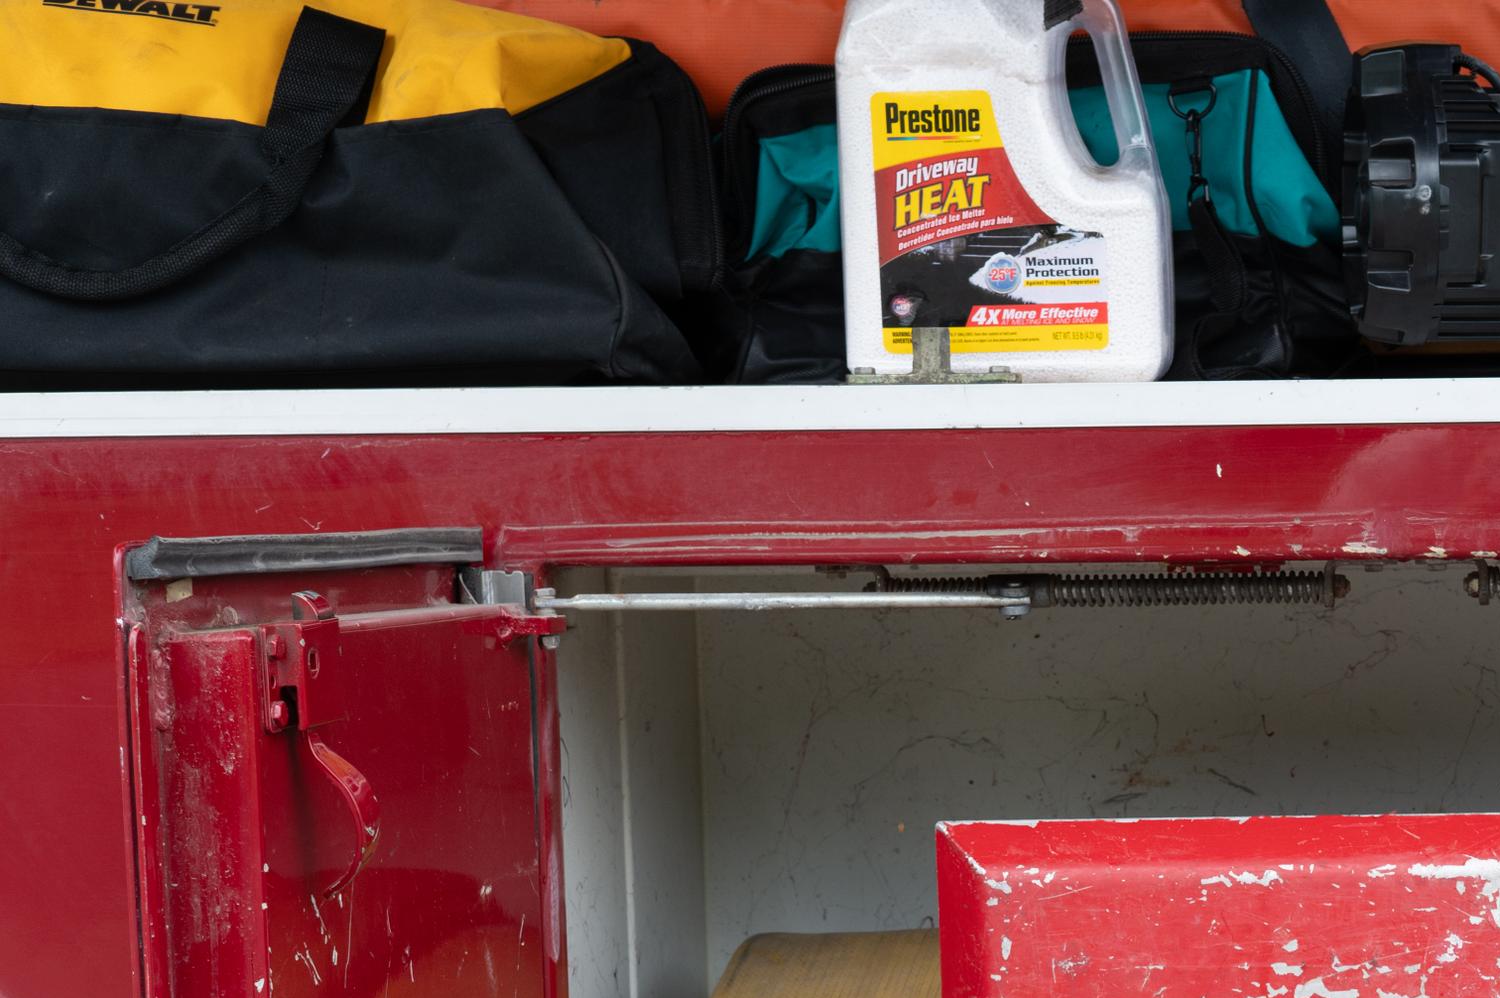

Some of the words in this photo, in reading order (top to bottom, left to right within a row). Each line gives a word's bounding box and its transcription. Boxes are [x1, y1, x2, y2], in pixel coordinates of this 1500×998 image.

[42, 0, 222, 23] EWALT
[885, 102, 981, 134] Prestone
[895, 156, 979, 193] Driveway
[894, 173, 992, 231] HEAT
[897, 215, 948, 239] Concentrated
[948, 213, 961, 223] Ice
[962, 208, 986, 221] Melter
[898, 232, 935, 252] Derretidor
[936, 221, 980, 238] Concentrado
[980, 217, 996, 230] para
[996, 215, 1014, 226] hielo
[1025, 256, 1094, 267] Maximum
[1025, 267, 1099, 278] Protection
[1002, 308, 1037, 320] More
[1040, 306, 1098, 319] Effective
